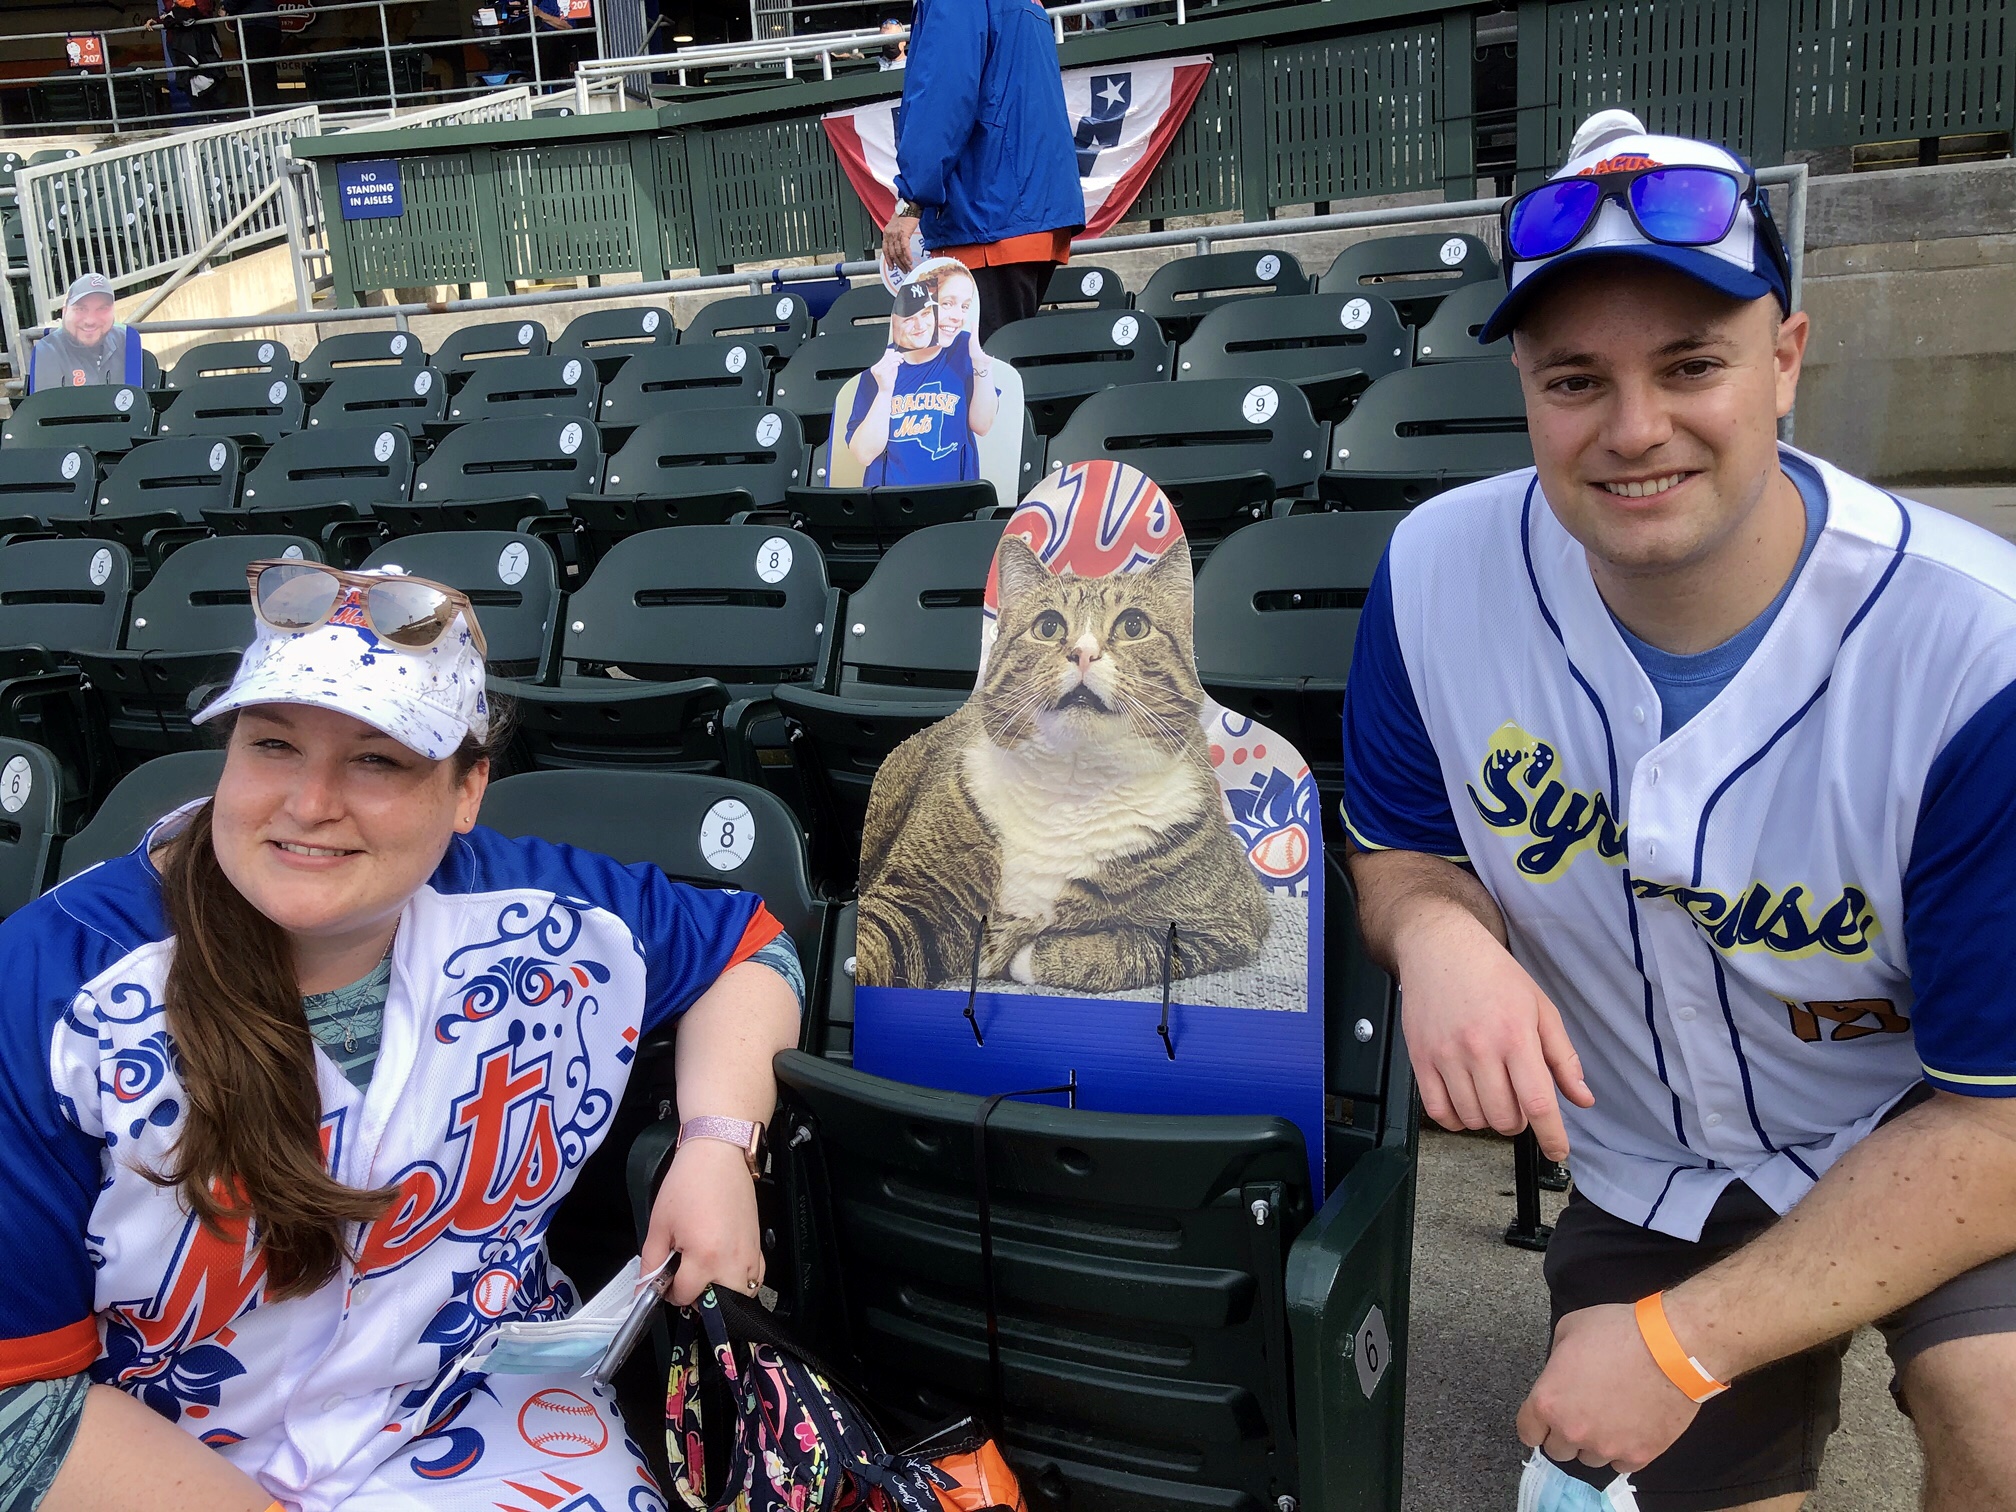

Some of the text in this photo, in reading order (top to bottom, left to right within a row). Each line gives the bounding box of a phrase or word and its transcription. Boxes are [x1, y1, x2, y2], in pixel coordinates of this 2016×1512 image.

[571, 1, 588, 10] 207
[83, 54, 100, 63] 207
[361, 173, 377, 182] NO
[346, 183, 395, 195] STANDING
[350, 195, 393, 206] IN AISLES
[1446, 247, 1461, 257] 10
[1264, 263, 1272, 272] 9
[1089, 280, 1095, 288] 8
[1352, 309, 1359, 319] 9
[1122, 326, 1128, 336] 8
[733, 355, 739, 364] 6
[569, 368, 575, 377] 5
[420, 379, 426, 387] 4
[275, 388, 281, 396] 3
[891, 393, 958, 416] RACUSE
[1256, 398, 1265, 411] 9
[766, 424, 773, 436] 7
[894, 414, 933, 438] Mets
[568, 433, 574, 443] 6
[381, 441, 388, 452] 5
[215, 453, 221, 462] 4
[68, 460, 74, 470] 3
[510, 555, 518, 571] 7
[770, 552, 779, 568] 8
[97, 560, 105, 574] 5
[11, 773, 20, 795] 6
[720, 822, 735, 849] 8
[1364, 1329, 1379, 1373] 6
